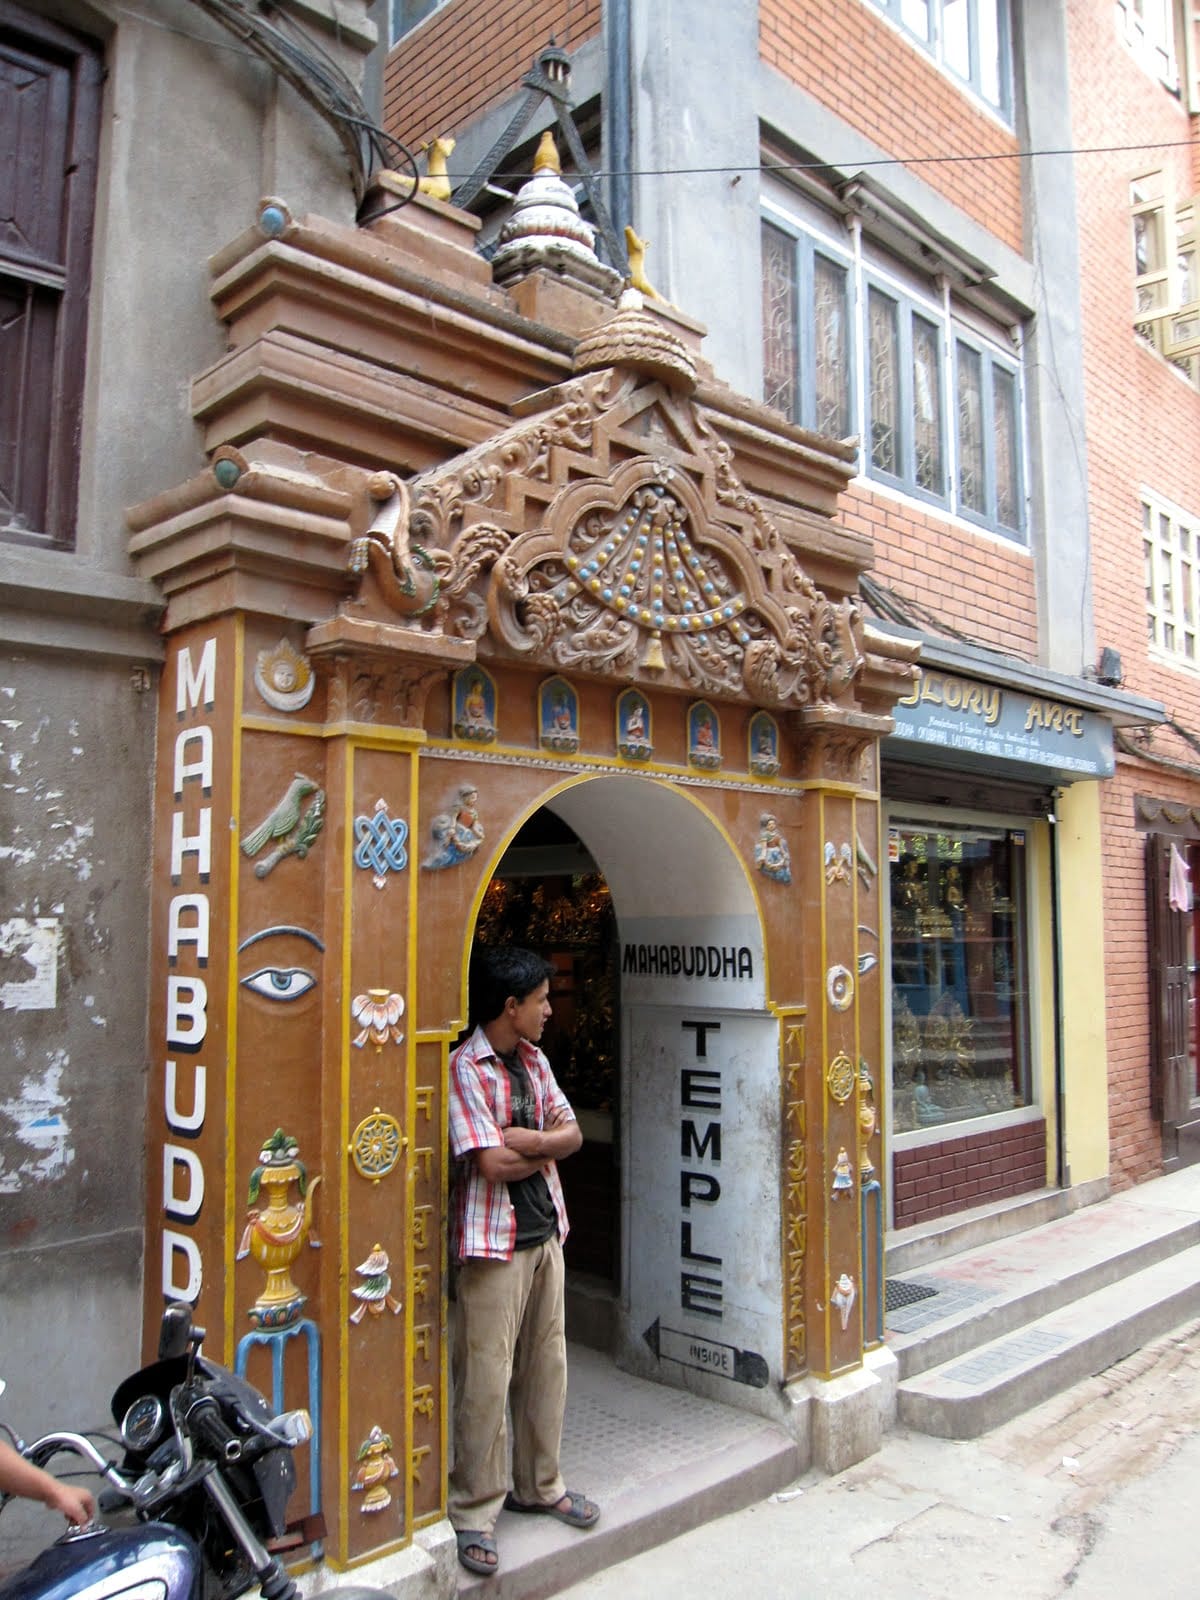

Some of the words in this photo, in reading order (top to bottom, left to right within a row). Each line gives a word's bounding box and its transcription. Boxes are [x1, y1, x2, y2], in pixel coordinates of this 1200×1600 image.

[1024, 700, 1084, 735] ART
[622, 944, 753, 979] MAHABUDDHA
[161, 636, 218, 1358] MAHABUDD
[680, 1020, 723, 1318] TEMPLE
[689, 1344, 729, 1371] INSIDE
